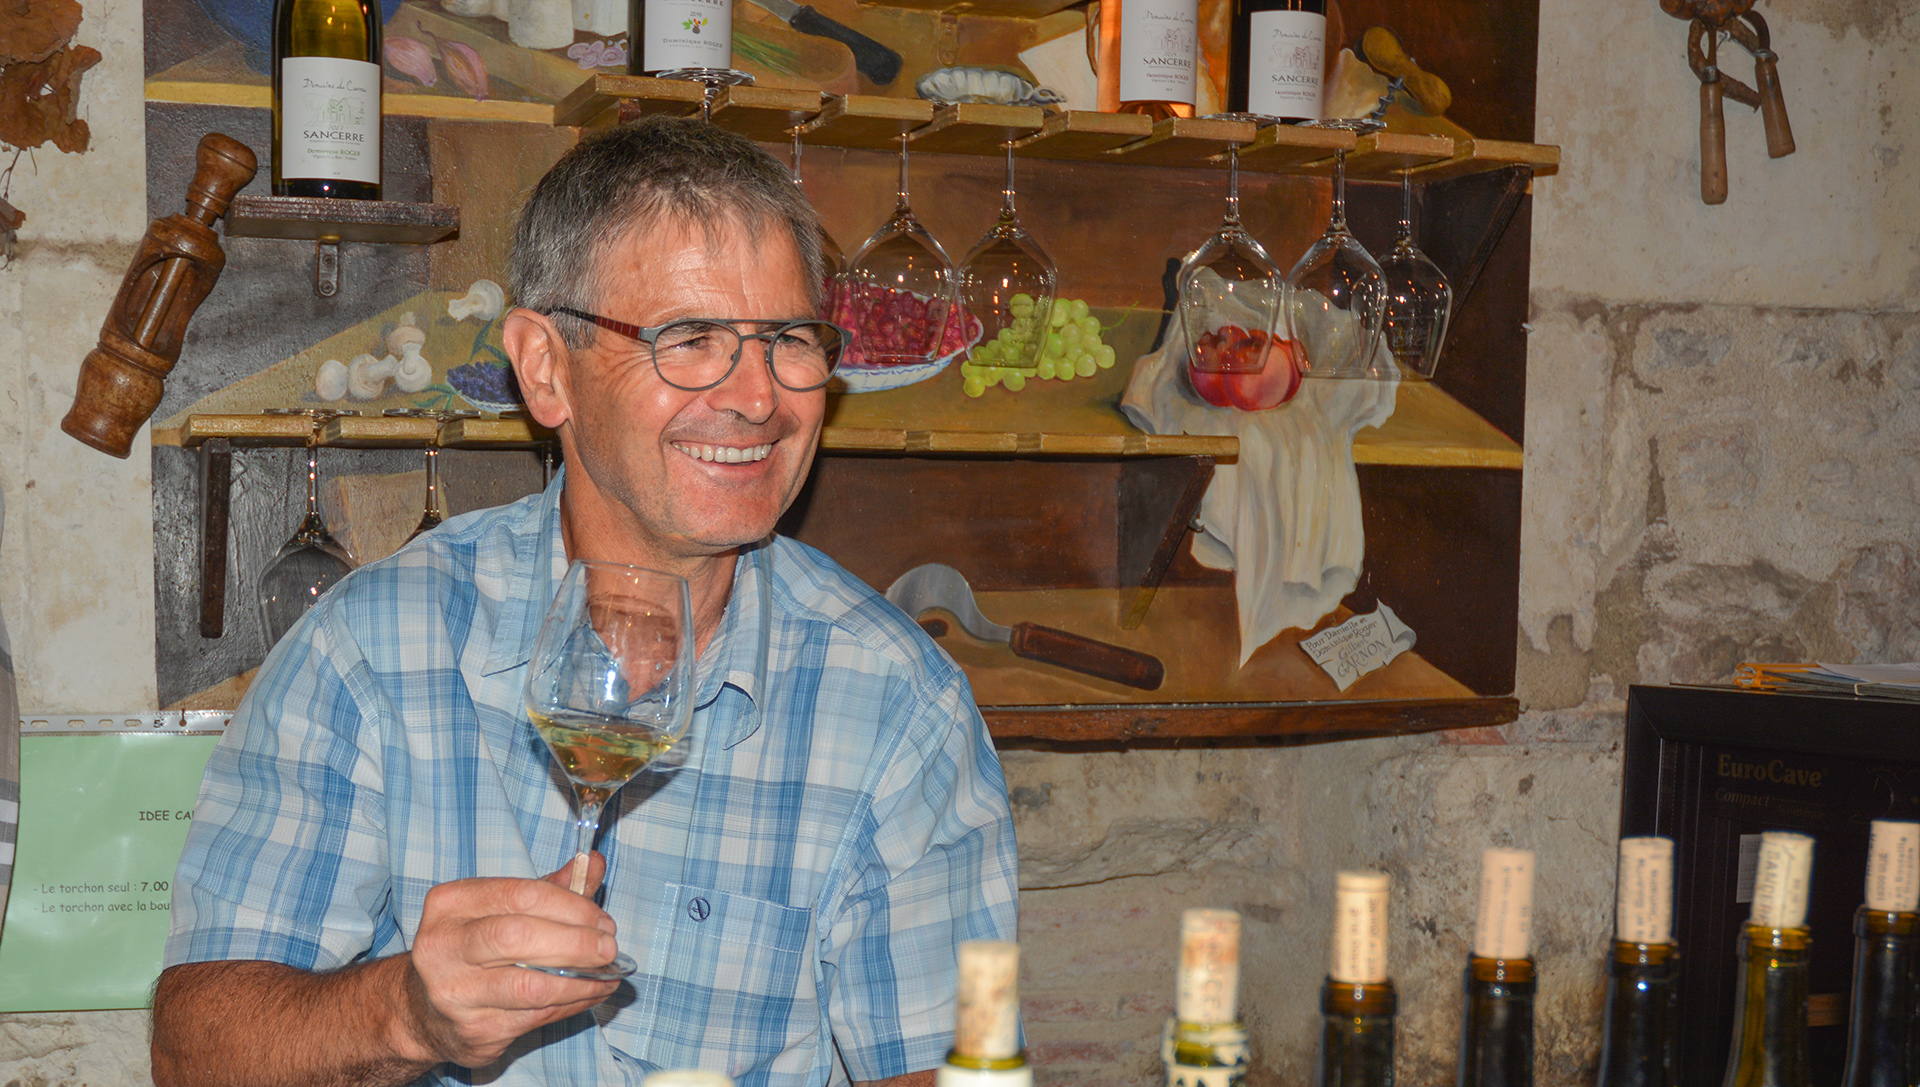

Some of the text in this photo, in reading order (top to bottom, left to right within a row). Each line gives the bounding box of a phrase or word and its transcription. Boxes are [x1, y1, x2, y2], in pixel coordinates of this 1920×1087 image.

[703, 40, 723, 48] ROGER
[1143, 57, 1191, 69] SANCERRE
[1272, 74, 1318, 86] SANCERRE
[303, 130, 365, 142] SANCERRE
[340, 148, 361, 157] ROGER
[1305, 637, 1325, 651] Pour
[1324, 620, 1359, 640] Danielle
[1312, 621, 1377, 658] Dominique Roger
[1338, 635, 1368, 660] Gilbert
[1337, 632, 1387, 677] GARNON
[1717, 753, 1823, 788] EuroCave
[1714, 787, 1770, 808] Compact
[139, 810, 194, 821] IDEE CA
[42, 884, 56, 894] Le
[59, 882, 104, 894] torchon
[107, 882, 130, 893] seul
[140, 881, 169, 892] 7.00
[42, 903, 56, 914] Le
[59, 901, 104, 913] torchon
[107, 903, 133, 912] avec
[136, 901, 147, 912] la
[150, 901, 172, 912] bou
